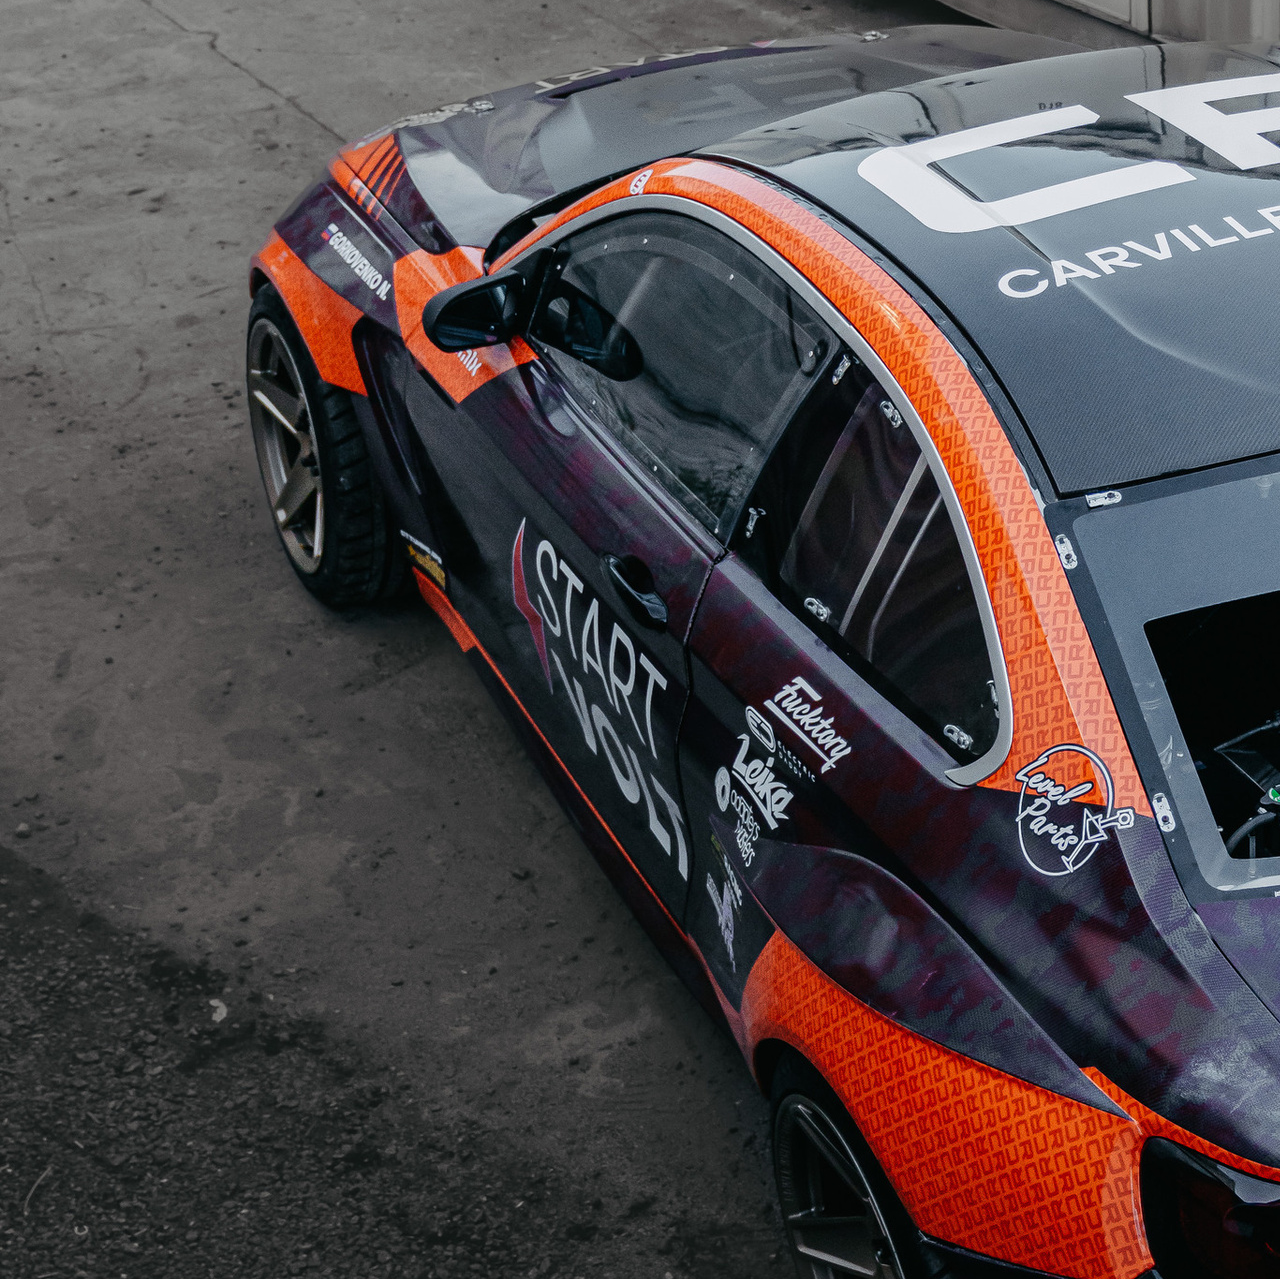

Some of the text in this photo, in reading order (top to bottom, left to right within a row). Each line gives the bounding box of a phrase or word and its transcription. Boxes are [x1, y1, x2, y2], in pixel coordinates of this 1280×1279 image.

[535, 539, 668, 760] START
[551, 647, 690, 882] VOLT
[772, 676, 852, 775] Fucktory
[1015, 756, 1094, 806] Level
[1015, 796, 1079, 851] Parts
